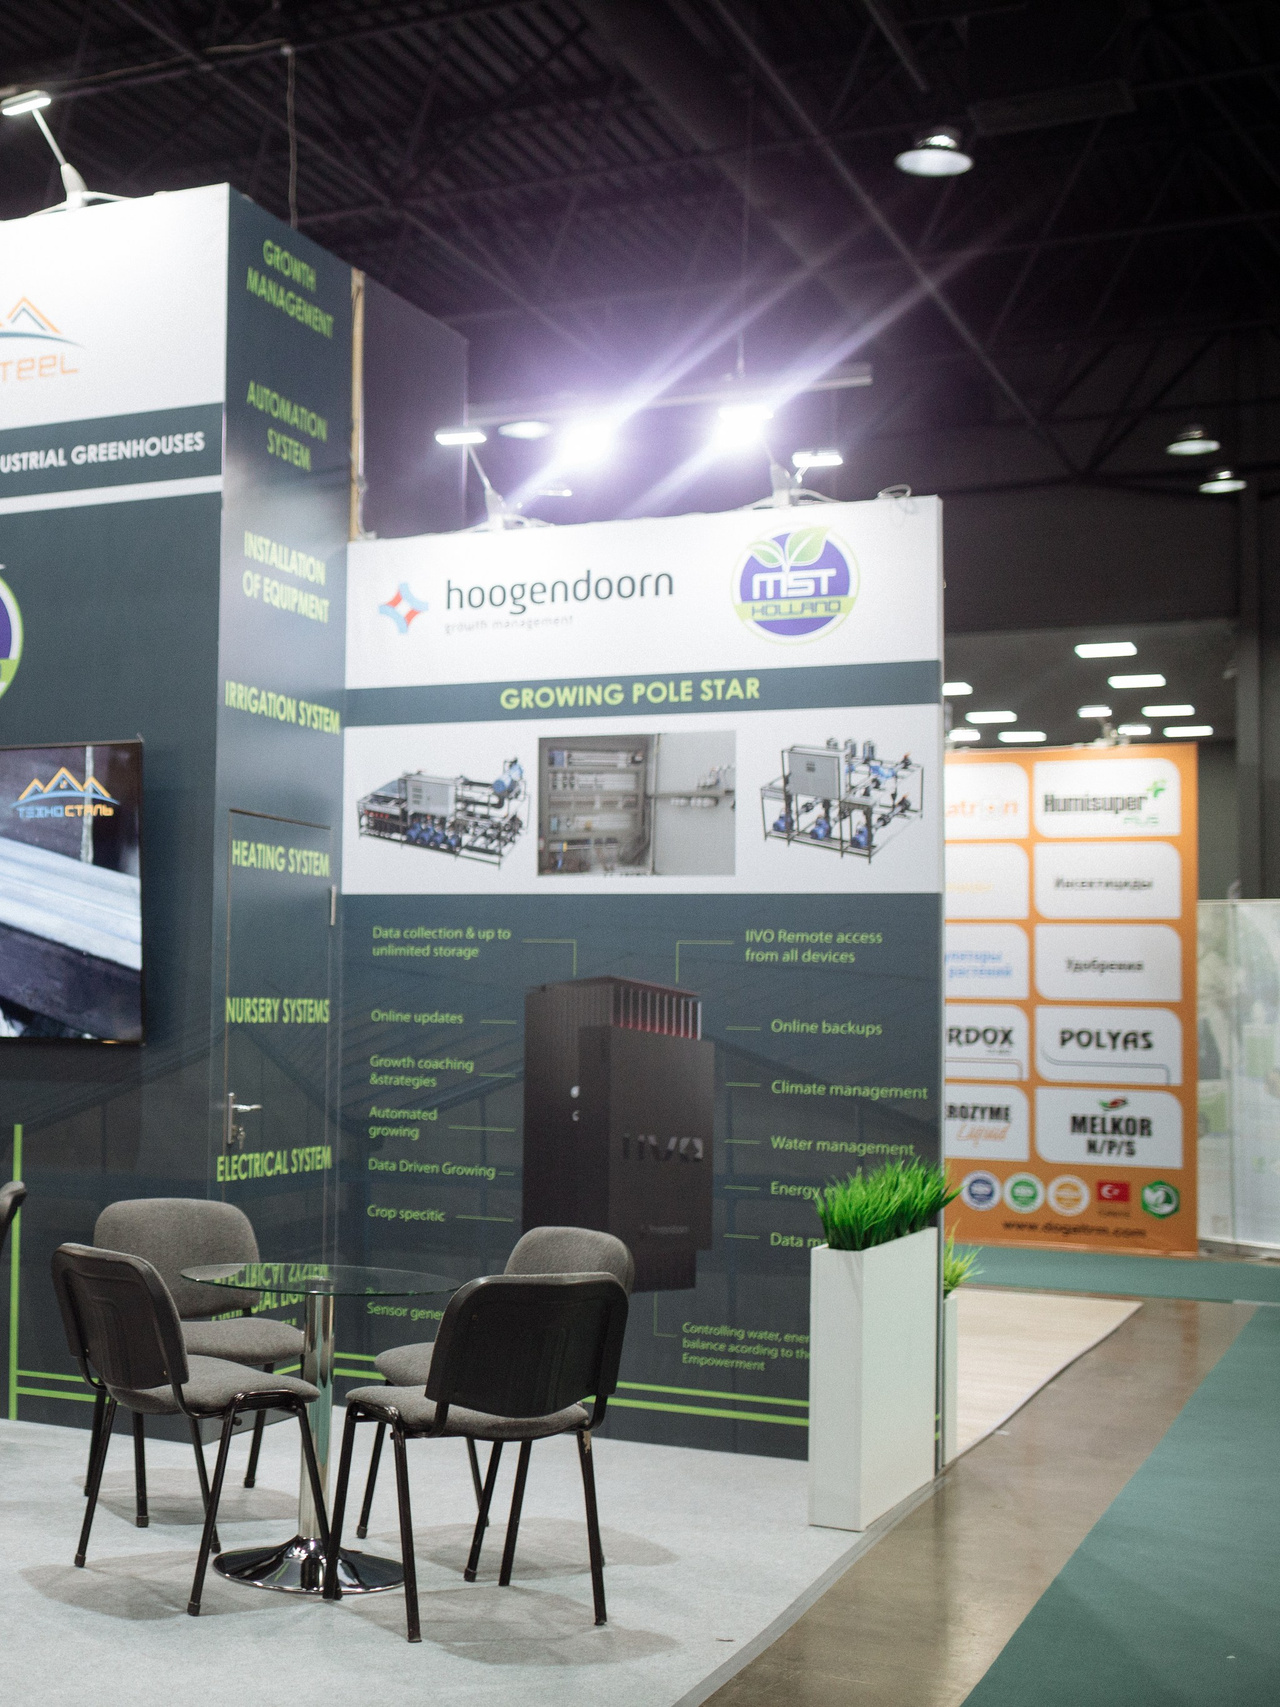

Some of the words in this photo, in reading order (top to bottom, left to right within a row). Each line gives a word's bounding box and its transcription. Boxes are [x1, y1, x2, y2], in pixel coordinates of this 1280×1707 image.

[263, 239, 317, 293] GROWTH
[246, 265, 334, 339] MANAGEMENT
[246, 380, 328, 443] AUTOMATION
[71, 431, 206, 465] GREENHOUSES
[267, 427, 312, 472] SYSTEM
[244, 530, 326, 586] INSTALLATION
[446, 569, 674, 615] hoogendoorn
[751, 568, 837, 600] MST
[242, 570, 261, 599] OF
[263, 577, 330, 624] EQUIPMENT
[751, 600, 841, 617] HOLLAND
[500, 682, 625, 710] GROWING
[632, 680, 693, 704] POLE
[700, 677, 760, 702] STAR
[225, 680, 297, 724] IRRIGATION
[298, 700, 341, 735] SYSTEM
[231, 839, 286, 872] HEATING
[288, 848, 330, 877] SYSTEM
[372, 926, 401, 939] Data
[403, 925, 463, 940] collection
[465, 926, 475, 940] &
[477, 929, 495, 942] up
[497, 928, 512, 940] to
[777, 929, 833, 944] Remote
[836, 931, 883, 944] access
[372, 943, 431, 957] unlimited
[433, 945, 480, 960] storage
[745, 947, 779, 962] from
[782, 948, 798, 962] all
[801, 948, 856, 964] devices
[226, 997, 280, 1023] NURSERY
[282, 998, 330, 1024] SYSTEMS
[371, 1008, 411, 1023] Online
[414, 1010, 464, 1026] updates
[771, 1018, 819, 1034] Online
[821, 1020, 883, 1038] backups
[1059, 1029, 1153, 1051] POLYAS
[369, 1054, 415, 1069] Growth
[417, 1057, 474, 1073] coaching
[771, 1079, 826, 1095] Climate
[829, 1085, 929, 1101] management
[369, 1106, 438, 1121] Automated
[946, 1104, 1011, 1123] ROZYME
[368, 1125, 420, 1141] growing
[1070, 1114, 1152, 1137] MELKOR
[771, 1135, 813, 1151] Water
[816, 1140, 915, 1157] management
[216, 1151, 289, 1182] ELECTRICAL
[291, 1145, 332, 1174] SYSTEM
[368, 1158, 397, 1172] Data
[399, 1159, 439, 1174] Driven
[441, 1162, 496, 1180] Growing
[771, 1181, 820, 1200] Energy
[367, 1204, 397, 1221] Crop
[770, 1232, 803, 1248] Data
[366, 1302, 407, 1318] Sensor
[682, 1321, 745, 1340] Controlling
[746, 1329, 782, 1343] water,
[682, 1337, 726, 1351] balance
[728, 1343, 779, 1359] acording
[781, 1348, 793, 1359] to
[682, 1352, 765, 1371] Empowerment
